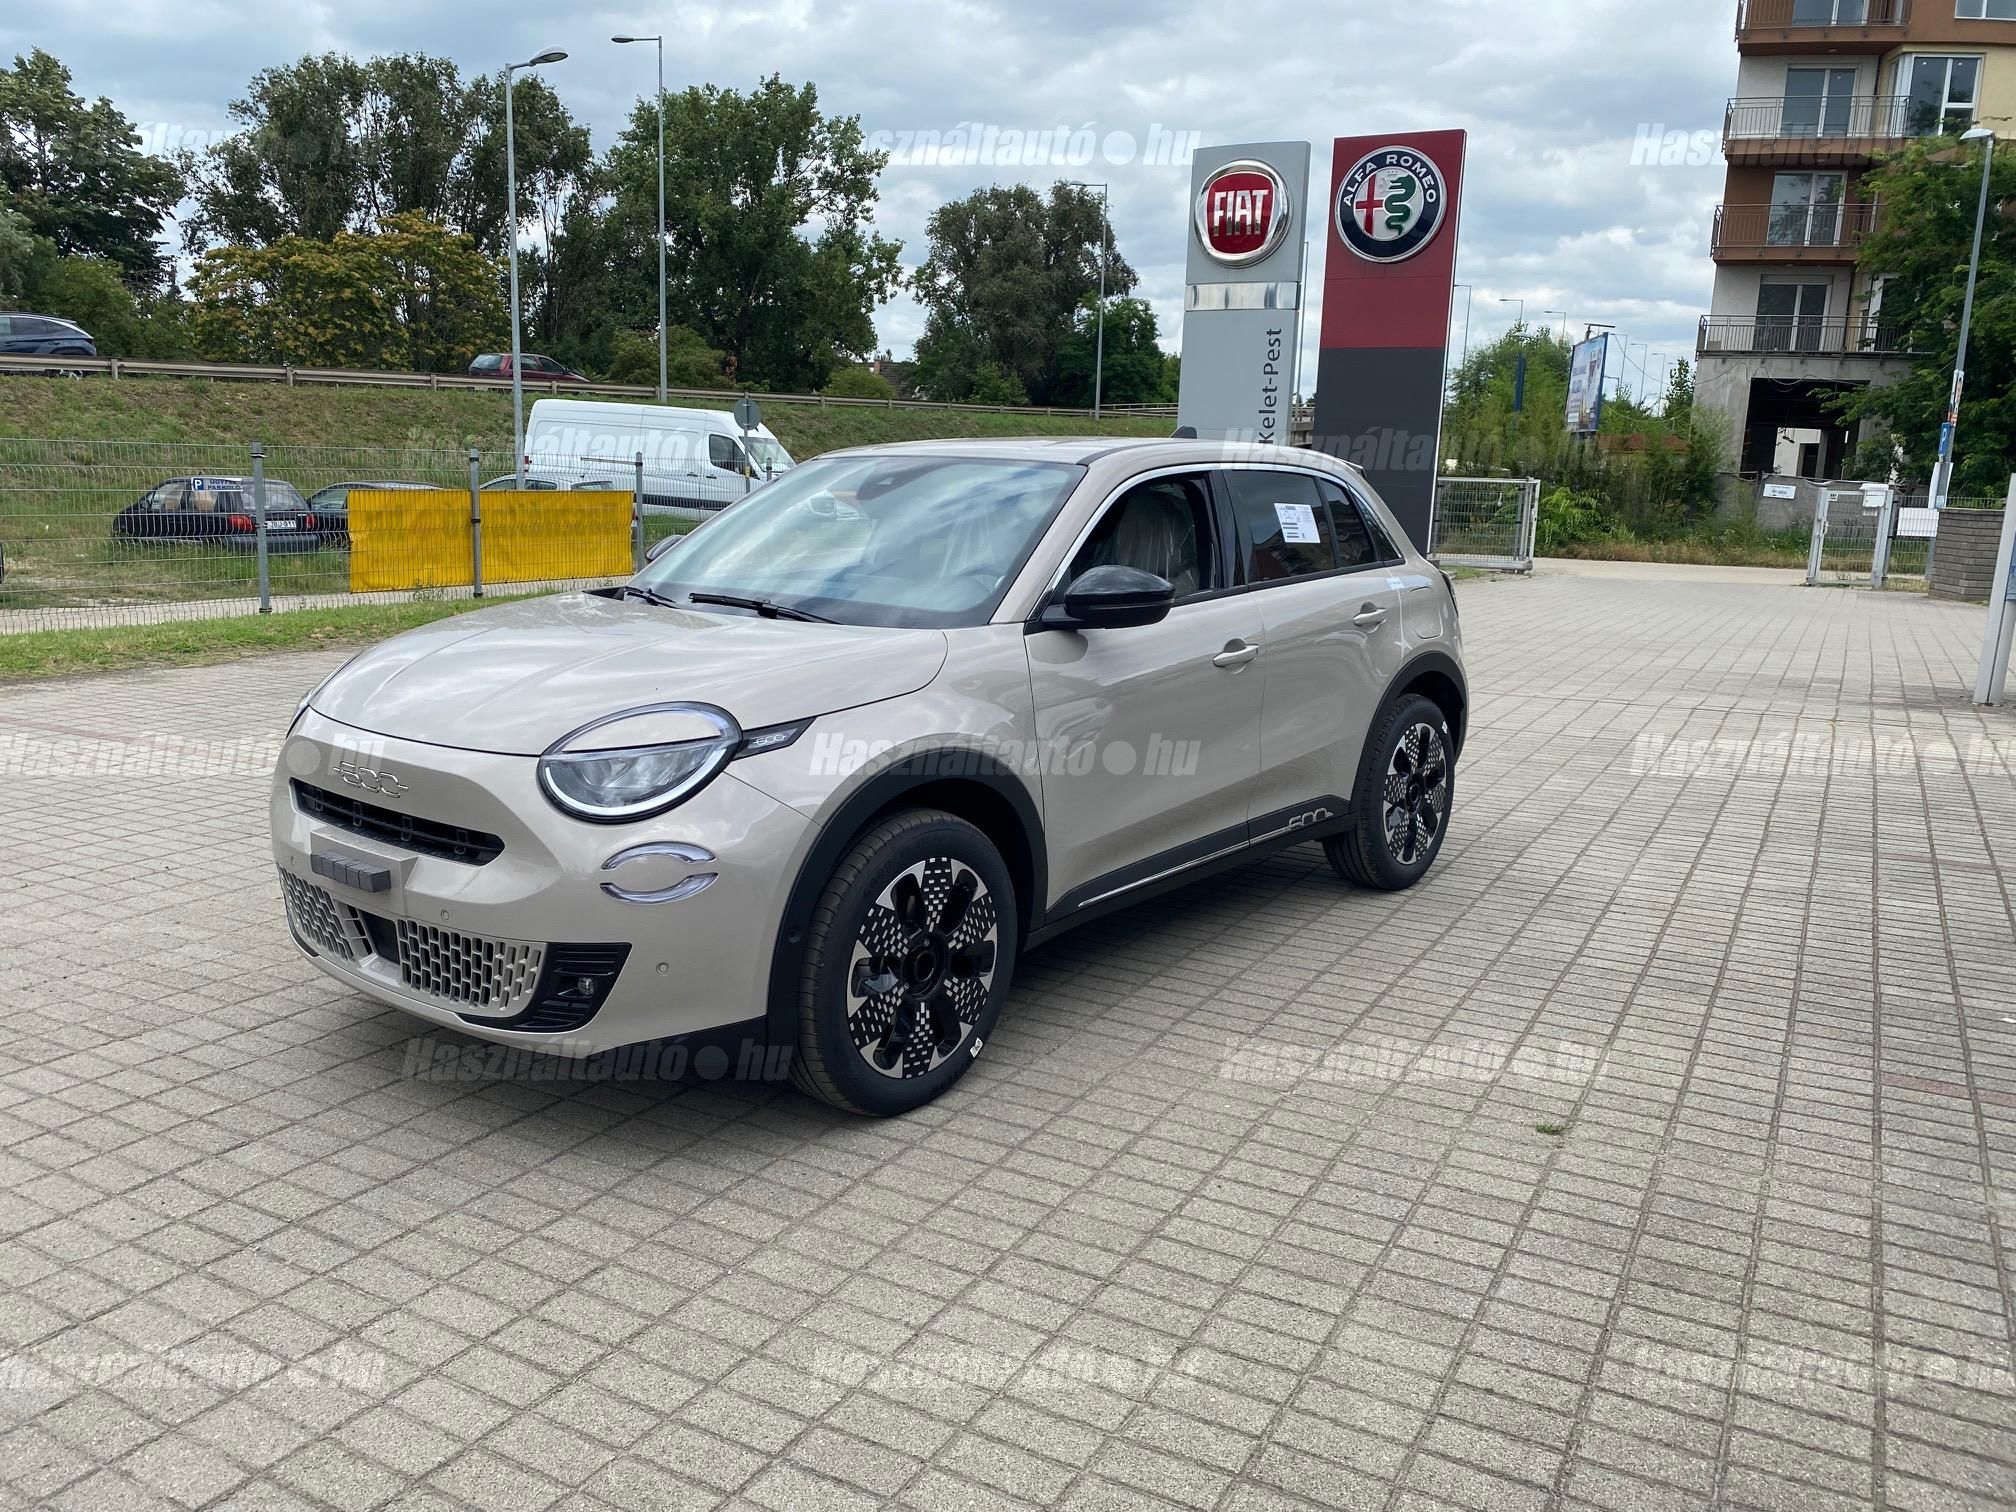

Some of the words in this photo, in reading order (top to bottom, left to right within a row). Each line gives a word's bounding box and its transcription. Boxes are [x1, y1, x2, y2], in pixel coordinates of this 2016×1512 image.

[1343, 161, 1378, 208] ALFA
[1385, 154, 1437, 204] ROMEO
[1213, 188, 1270, 238] FIAT
[1258, 327, 1283, 444] Kelet-Pest
